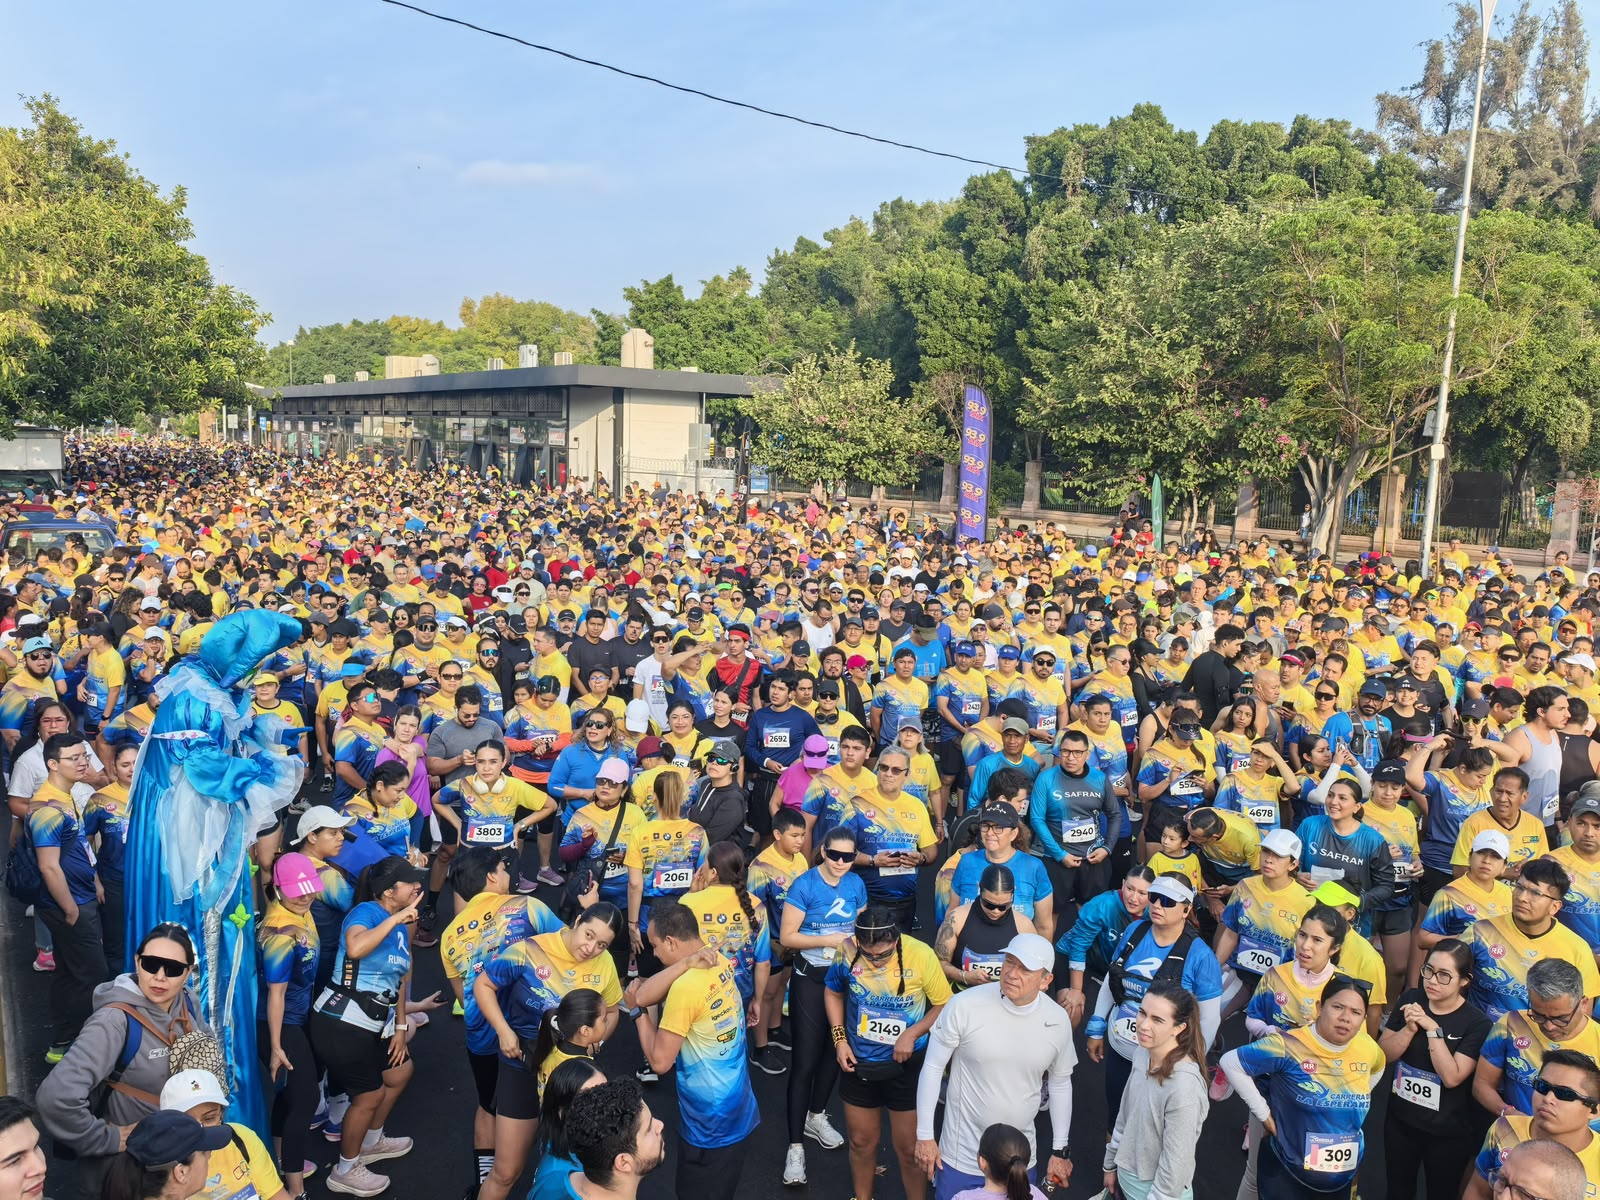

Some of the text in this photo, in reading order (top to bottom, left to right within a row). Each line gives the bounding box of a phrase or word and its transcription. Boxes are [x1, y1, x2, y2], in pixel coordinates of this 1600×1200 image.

[967, 400, 987, 416] 93.9
[965, 427, 986, 443] 93.9
[963, 454, 985, 470] 93.9
[961, 481, 983, 497] 93.9
[960, 507, 982, 523] 93.9
[769, 735, 787, 743] 2692
[1238, 760, 1252, 768] 304
[1064, 791, 1101, 799] SAFRAN
[1249, 809, 1273, 818] 4678
[476, 827, 502, 836] 3803
[1070, 827, 1094, 837] 2940
[1319, 848, 1364, 866] SAFRAN
[664, 872, 689, 882] 2061
[483, 911, 492, 921] G
[732, 913, 741, 922] G
[1250, 951, 1273, 967] 700
[537, 968, 549, 977] RR
[869, 1020, 901, 1037] 2149
[1303, 1063, 1315, 1071] RR
[1404, 1078, 1432, 1099] 308
[1296, 1094, 1370, 1109] LA ESPERANZ
[1330, 1093, 1365, 1101] CARRERA
[1324, 1149, 1352, 1162] 309
